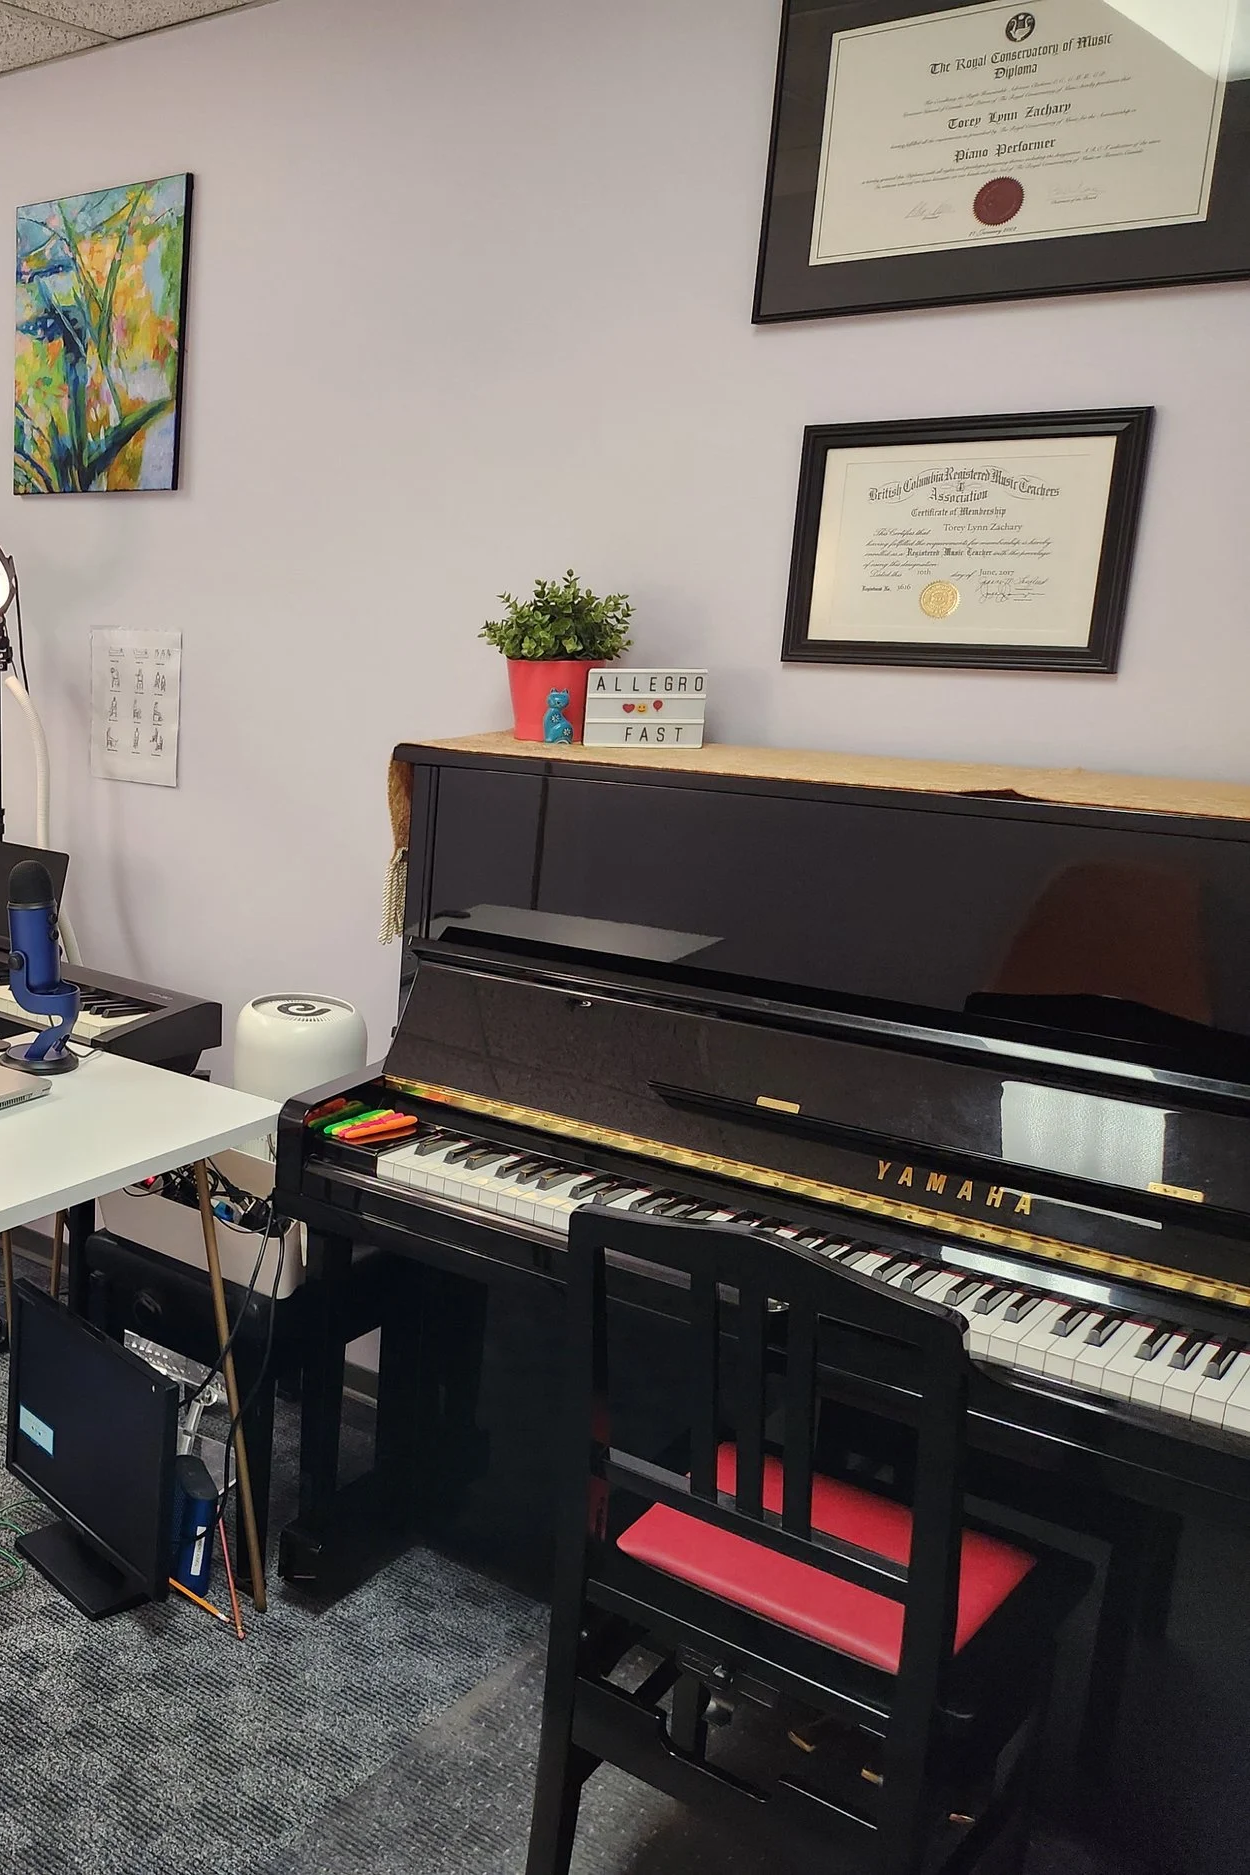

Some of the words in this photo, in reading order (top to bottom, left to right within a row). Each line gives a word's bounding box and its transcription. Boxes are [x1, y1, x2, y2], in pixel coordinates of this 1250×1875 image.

[930, 62, 951, 74] The
[956, 54, 986, 71] Royal
[990, 42, 1059, 64] Conservatory
[1062, 38, 1074, 51] of
[1076, 32, 1113, 50] Music
[994, 63, 1038, 80] Diploma
[948, 114, 982, 130] Torey
[988, 110, 1018, 126] Lynn
[1024, 102, 1072, 120] Zachary
[954, 148, 988, 163] Piano
[996, 138, 1056, 158] Performer
[868, 485, 902, 502] British
[902, 472, 944, 493] Columbia
[944, 466, 990, 483] Registered
[990, 468, 1018, 490] Music
[1018, 478, 1060, 498] Teachers
[928, 487, 988, 504] Association
[910, 507, 948, 518] Certificate
[950, 506, 958, 516] of
[958, 506, 1006, 518] Membership
[873, 528, 888, 536] This
[943, 524, 966, 534] Torey
[967, 523, 988, 533] Lynn
[990, 522, 1022, 532] Zachary
[906, 547, 940, 558] Registered
[943, 547, 964, 556] Music
[967, 547, 992, 556] Teacher
[596, 675, 704, 692] ALLEGRO
[624, 726, 684, 742] FAST
[877, 1160, 1032, 1215] YAMAHA
